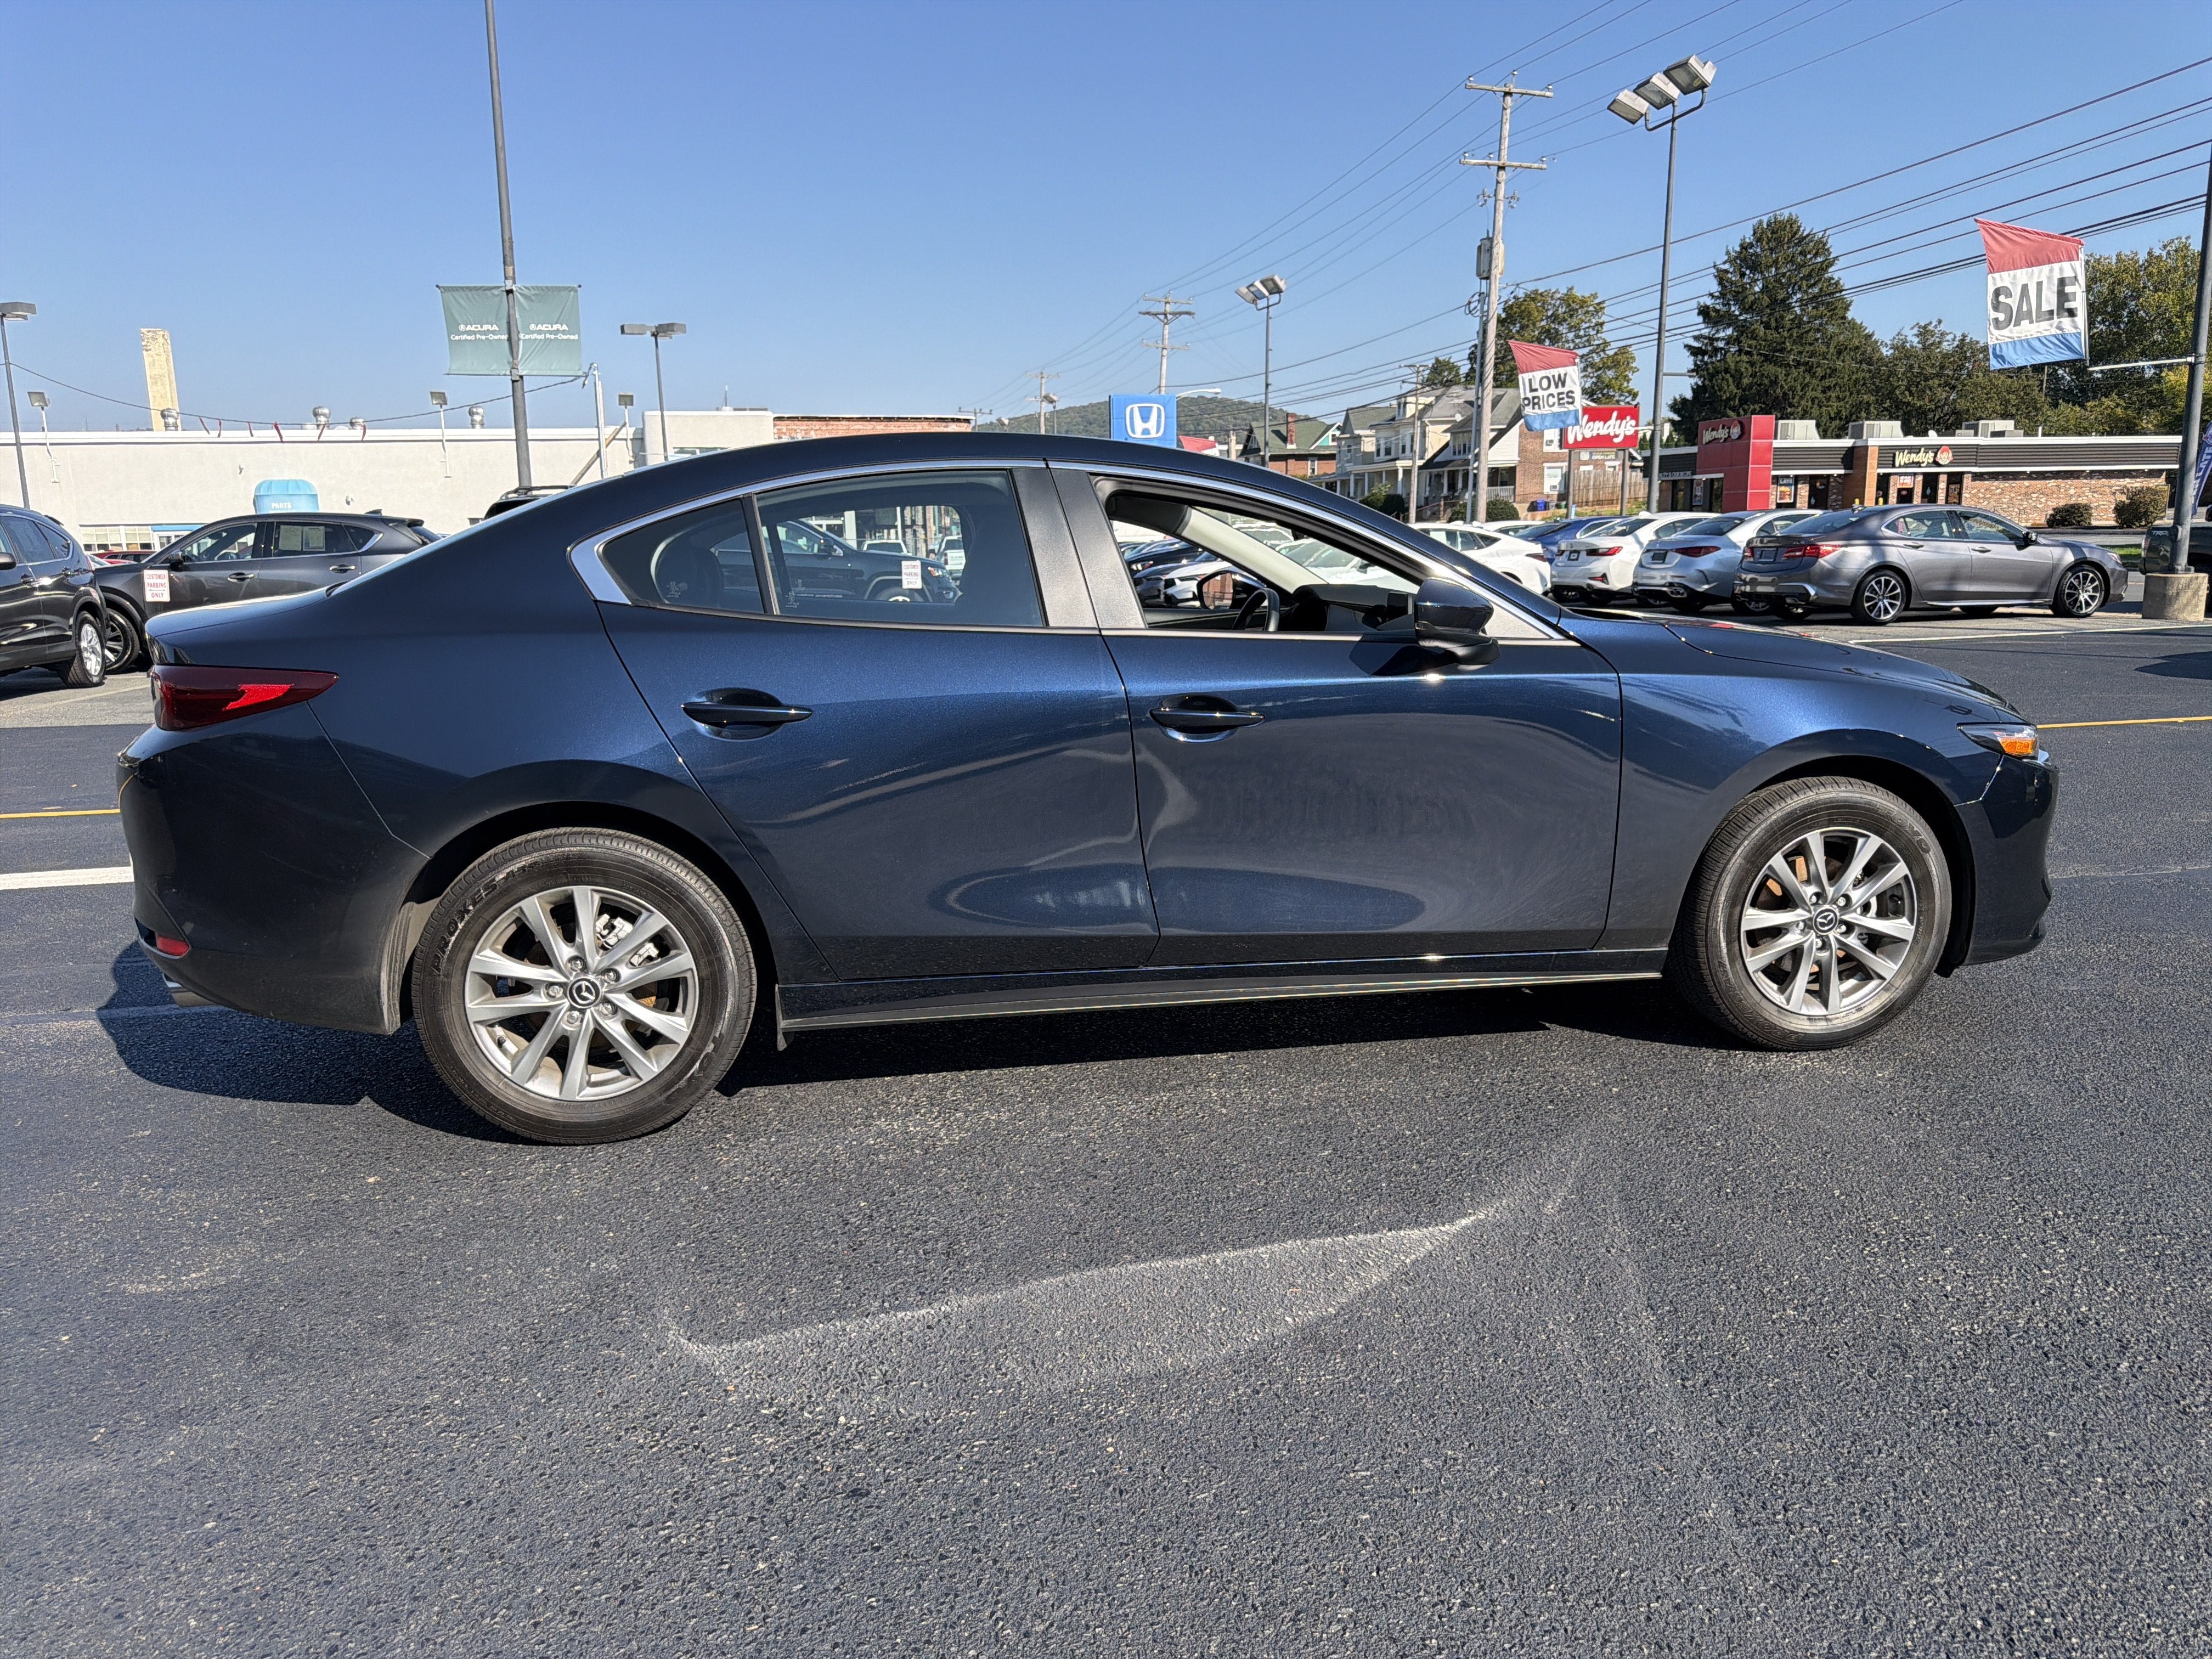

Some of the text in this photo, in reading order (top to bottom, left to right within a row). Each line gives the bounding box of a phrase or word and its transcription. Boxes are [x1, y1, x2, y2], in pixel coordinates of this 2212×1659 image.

[1991, 276, 2078, 331] SALE
[1528, 372, 1567, 393] LOW
[1522, 390, 1576, 410] PRICES
[1567, 410, 1636, 444] Wendy's
[1702, 424, 1729, 445] Wendy's
[1895, 447, 1934, 467] Wendy's
[1876, 804, 1931, 854] TOYO
[430, 877, 498, 975] PROXES
